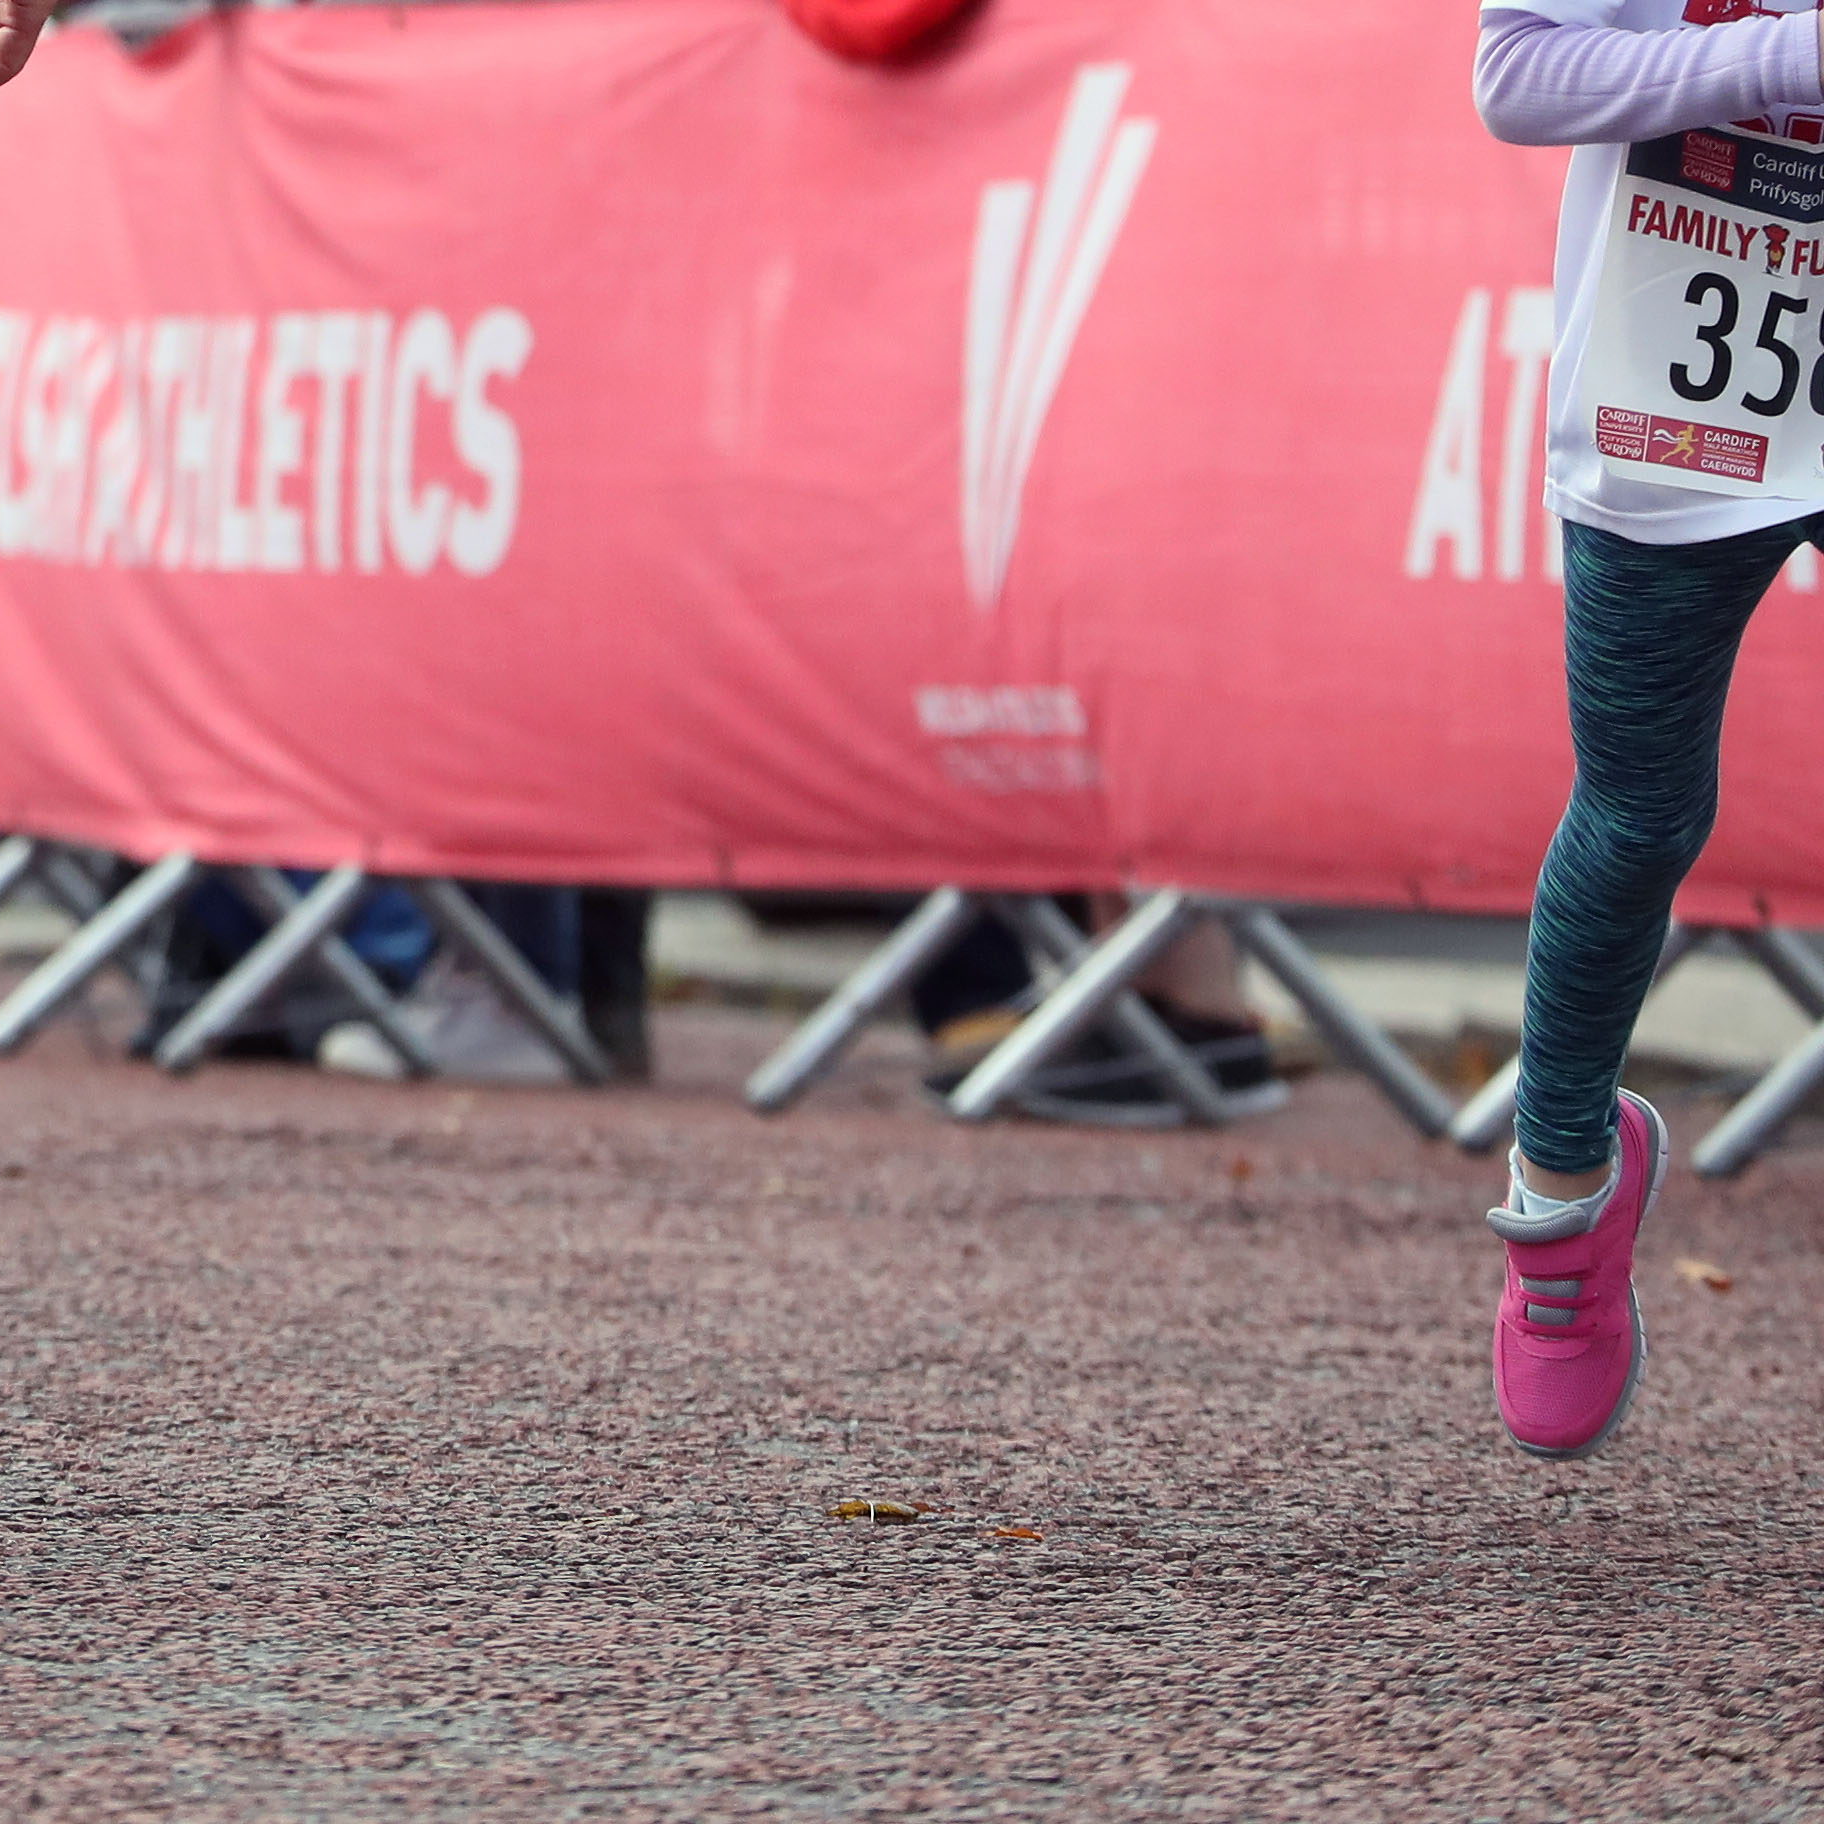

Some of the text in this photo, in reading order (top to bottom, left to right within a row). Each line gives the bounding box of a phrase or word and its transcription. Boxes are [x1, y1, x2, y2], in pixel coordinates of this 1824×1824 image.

[1753, 152, 1817, 182] Cardiff
[1749, 178, 1824, 211] Prifysgol
[1627, 194, 1762, 264] FAMILY
[1599, 408, 1647, 426] CARDIFF
[88, 306, 536, 578] ATHLETICS
[1704, 430, 1761, 450] CARDIFF
[1701, 458, 1757, 478] CAERDYDD
